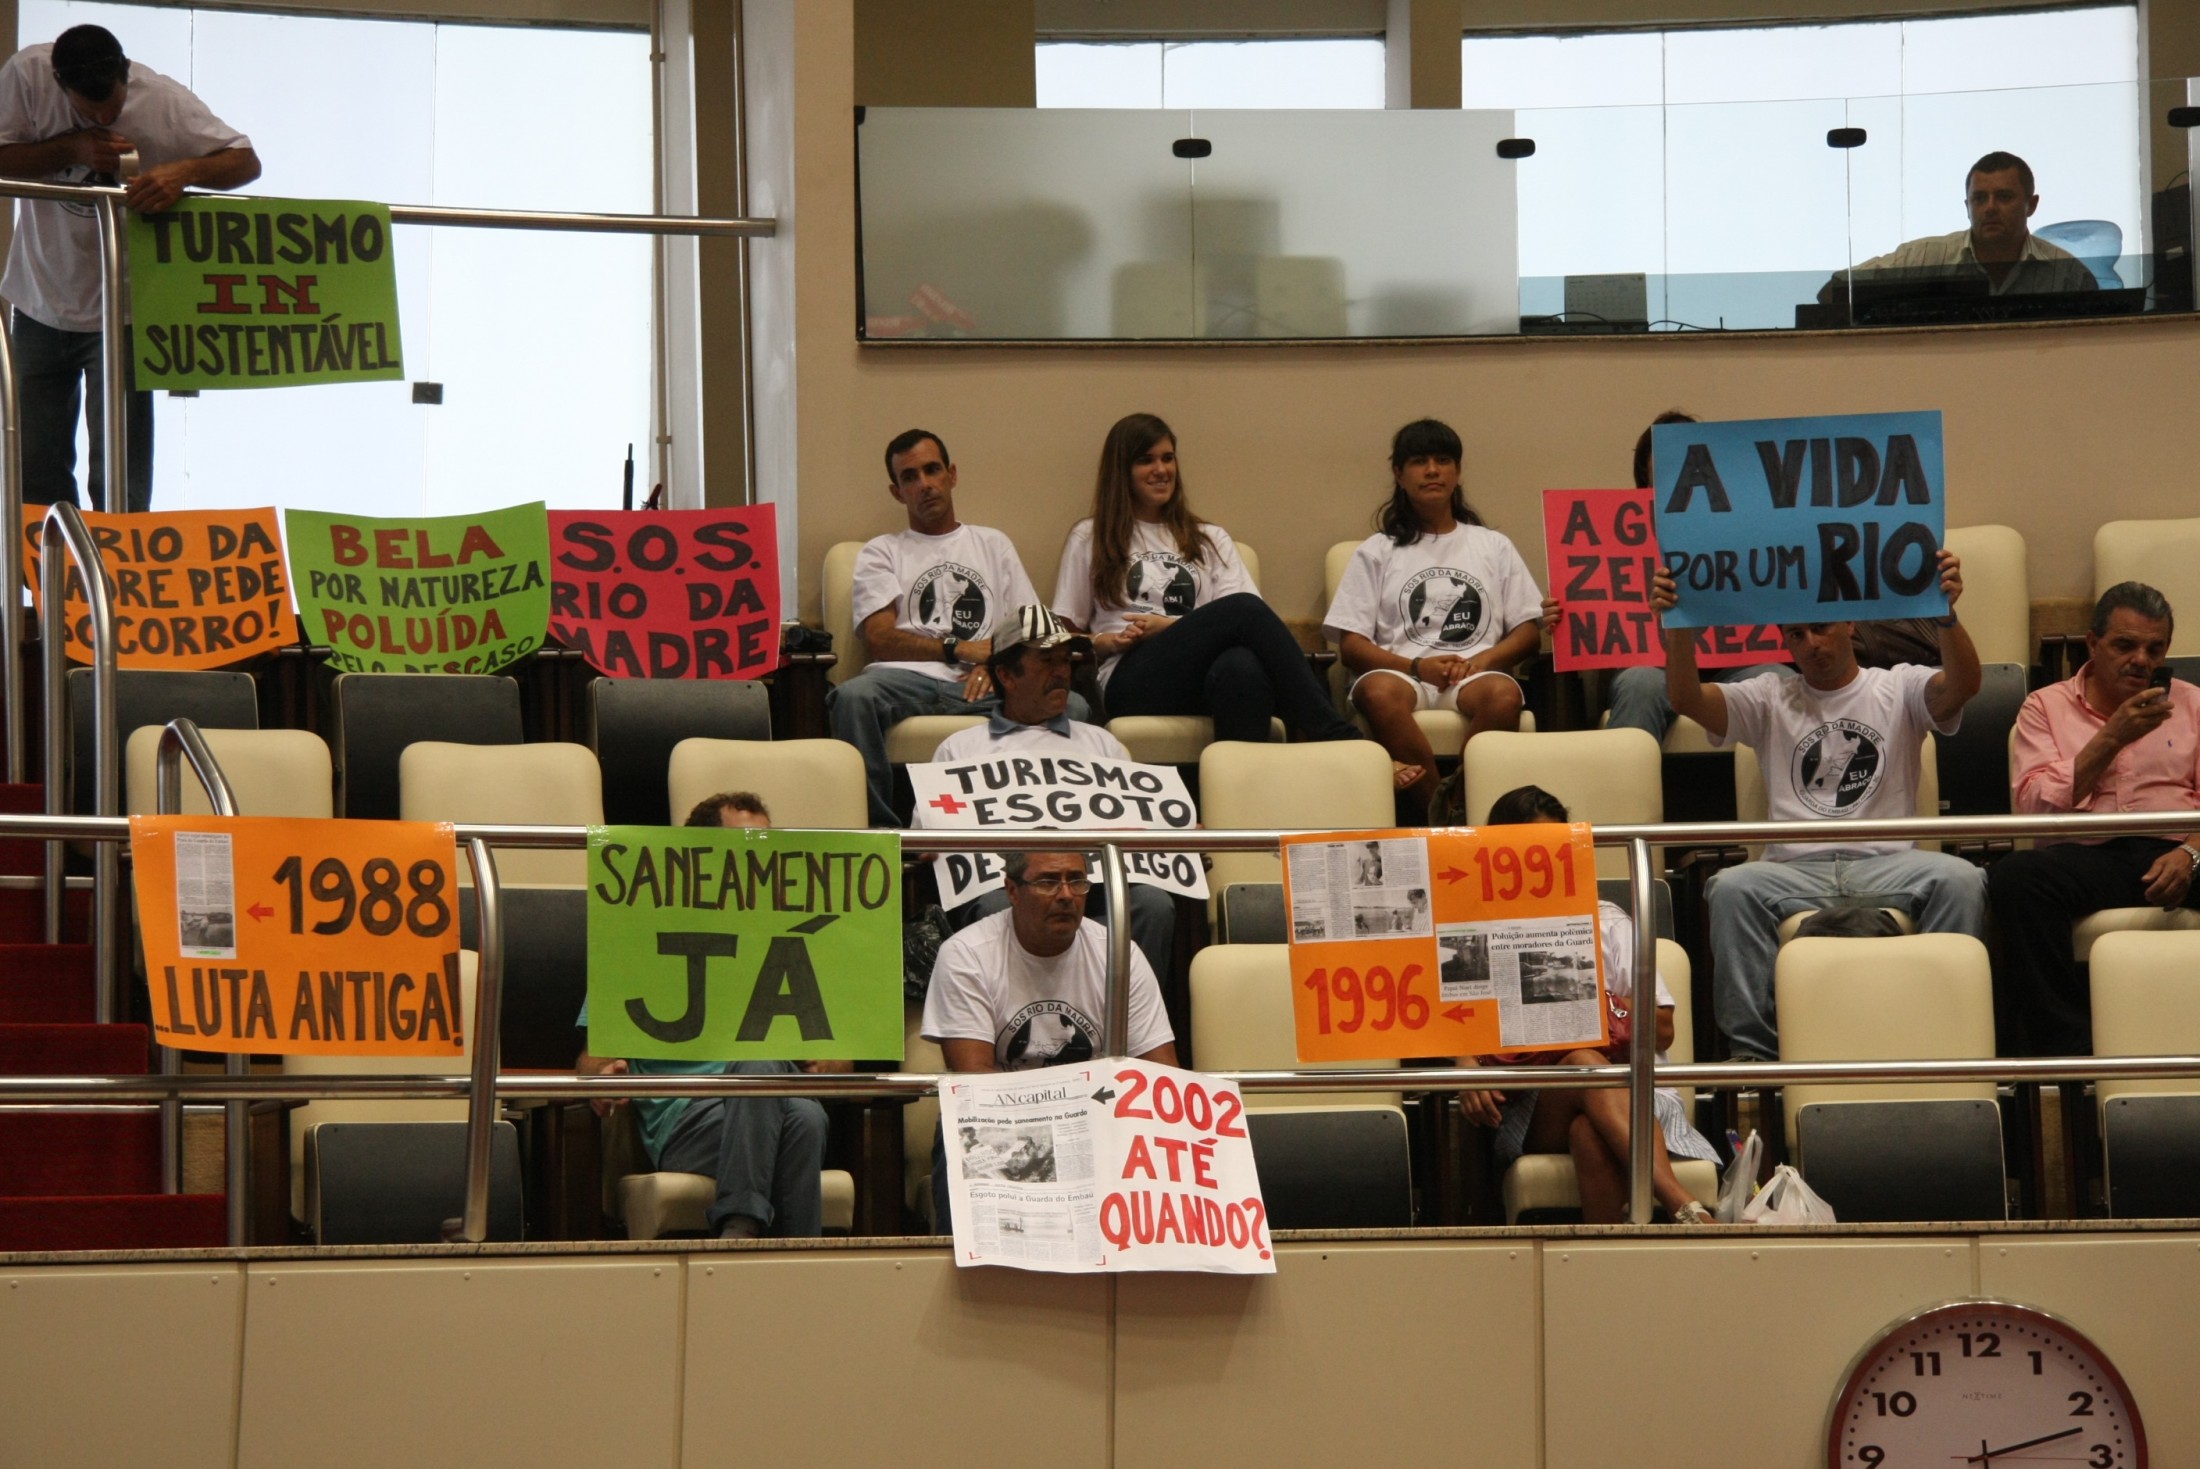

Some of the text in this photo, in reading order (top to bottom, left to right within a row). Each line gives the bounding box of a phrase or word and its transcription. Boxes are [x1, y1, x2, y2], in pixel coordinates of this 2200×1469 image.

[142, 210, 384, 265] TURISMO
[197, 274, 321, 314] IN
[143, 313, 400, 376] SUSTENTÁVEL
[1664, 433, 1931, 514] A VIDA
[91, 525, 183, 563] RIO
[207, 522, 278, 562] DA
[1560, 500, 1601, 547] A
[330, 524, 506, 570] BELA
[557, 521, 762, 575] S.O.S.
[1664, 521, 1940, 604] POR UM RIO
[188, 559, 285, 608] PEDE
[309, 560, 545, 609] POR NATUREZA
[551, 578, 766, 622] RIO DA
[914, 578, 929, 596] SOS
[928, 568, 943, 580] RIO
[958, 568, 986, 590] MADRE
[1404, 578, 1420, 595] SOS
[1420, 570, 1436, 581] RIO
[1455, 572, 1484, 594] MADRE
[65, 599, 281, 658] OCORRO!
[321, 607, 508, 656] POLUÍDA
[956, 611, 972, 619] EU
[1454, 612, 1471, 621] EU
[1799, 737, 1816, 754] SOS
[1833, 722, 1845, 730] DA
[1848, 723, 1881, 745] MADRE
[945, 757, 1164, 796] TURISMO
[1850, 770, 1868, 781] EU
[972, 790, 1192, 828] ESGOTO
[595, 843, 891, 912] SANEAMENTO
[1473, 842, 1577, 902] 1991
[272, 855, 451, 938] 1988
[1492, 932, 1524, 940] Poluição
[1526, 931, 1558, 939] aumenta
[1513, 942, 1553, 950] moradores
[289, 951, 464, 1048] ANTIGA!
[624, 914, 841, 1043] JÁ
[1304, 964, 1430, 1035] 1996
[1008, 1004, 1097, 1038] SOS RIO DA MADRE
[1015, 1116, 1053, 1125] saneamento
[1065, 1110, 1088, 1119] Guarda
[1113, 1069, 1247, 1138] 2002
[1121, 1133, 1220, 1190] ATÉ
[1026, 1195, 1054, 1203] Guarda
[1068, 1192, 1094, 1202] Embaú
[1100, 1190, 1271, 1261] QUANDO?
[1910, 1351, 2043, 1377] 11 1
[1957, 1332, 2002, 1358] 12
[1872, 1390, 2095, 1418] 10 2
[1858, 1444, 2114, 1469] 9 3
